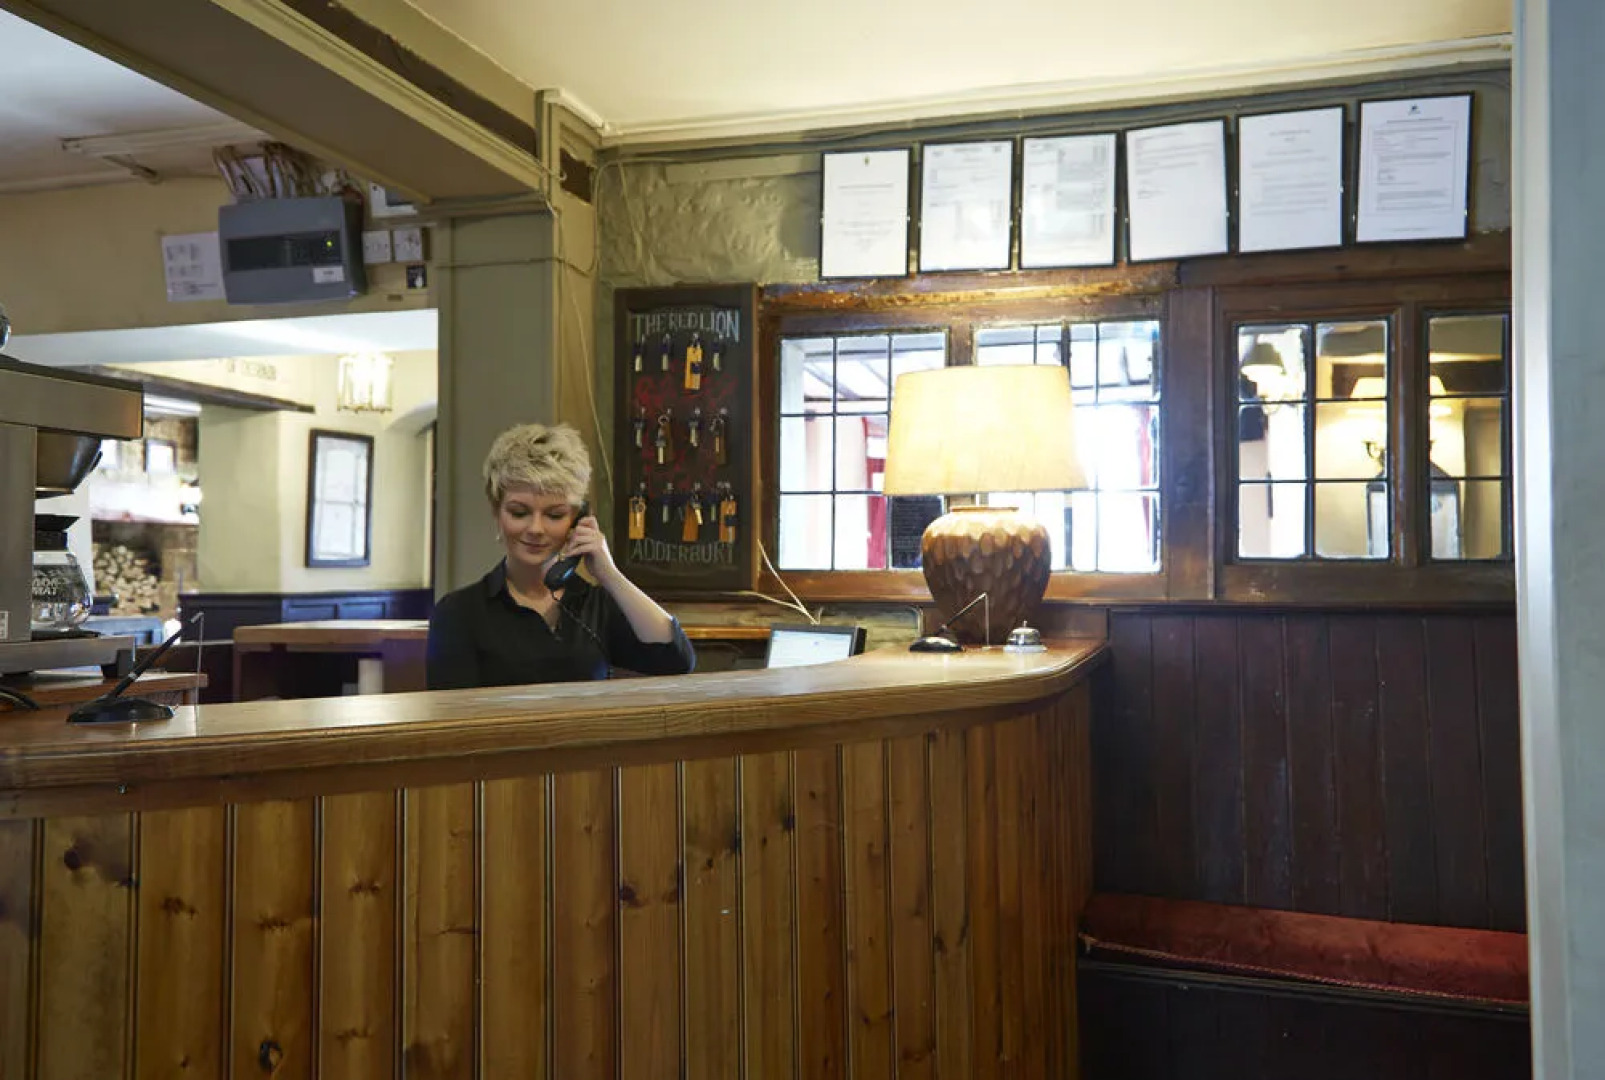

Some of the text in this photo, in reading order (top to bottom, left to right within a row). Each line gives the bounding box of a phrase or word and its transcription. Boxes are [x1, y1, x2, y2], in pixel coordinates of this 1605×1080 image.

[631, 309, 740, 342] THE RED LION
